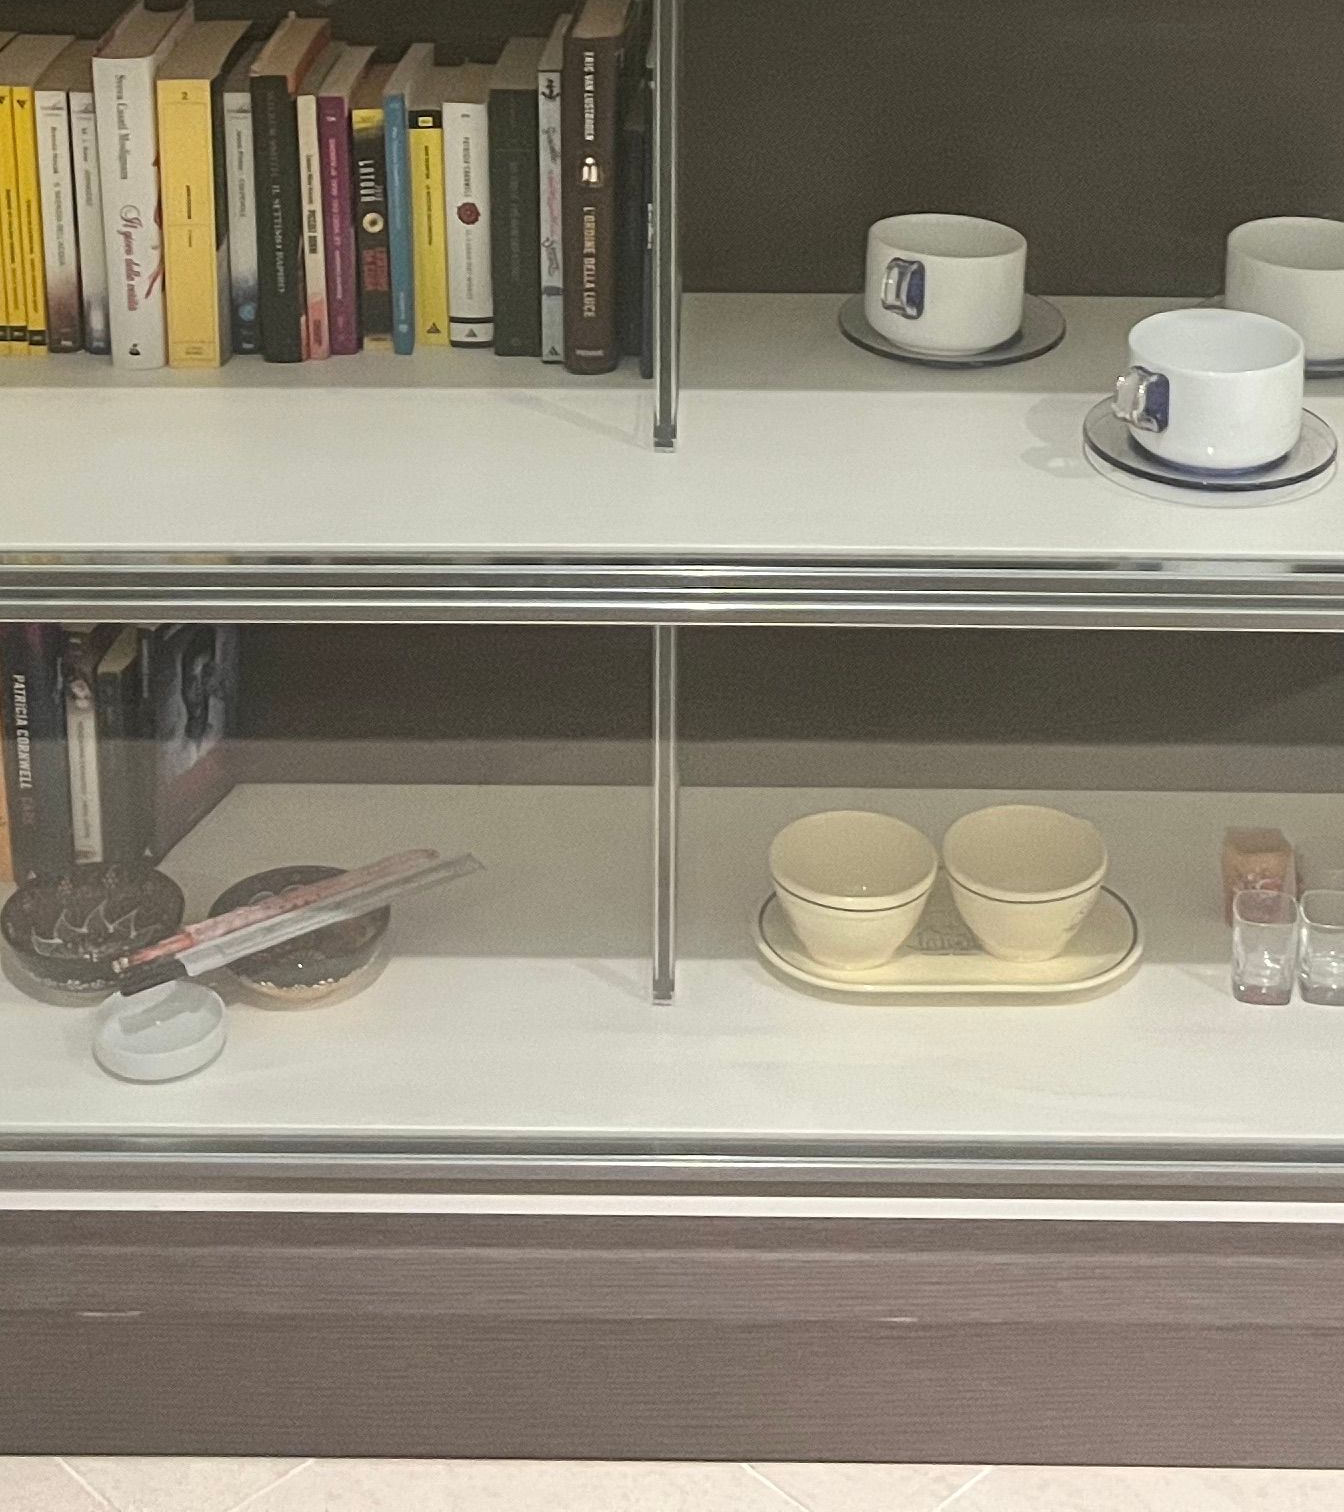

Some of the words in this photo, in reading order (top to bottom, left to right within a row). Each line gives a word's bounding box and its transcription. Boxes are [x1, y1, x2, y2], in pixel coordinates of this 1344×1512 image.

[584, 74, 595, 91] VAN
[272, 197, 283, 249] SETTIMO
[583, 207, 597, 255] L'ORDINE
[583, 256, 596, 289] DELLA
[583, 291, 596, 318] LUCE
[12, 673, 28, 726] PATRICIA
[16, 728, 33, 789] CORNWELL
